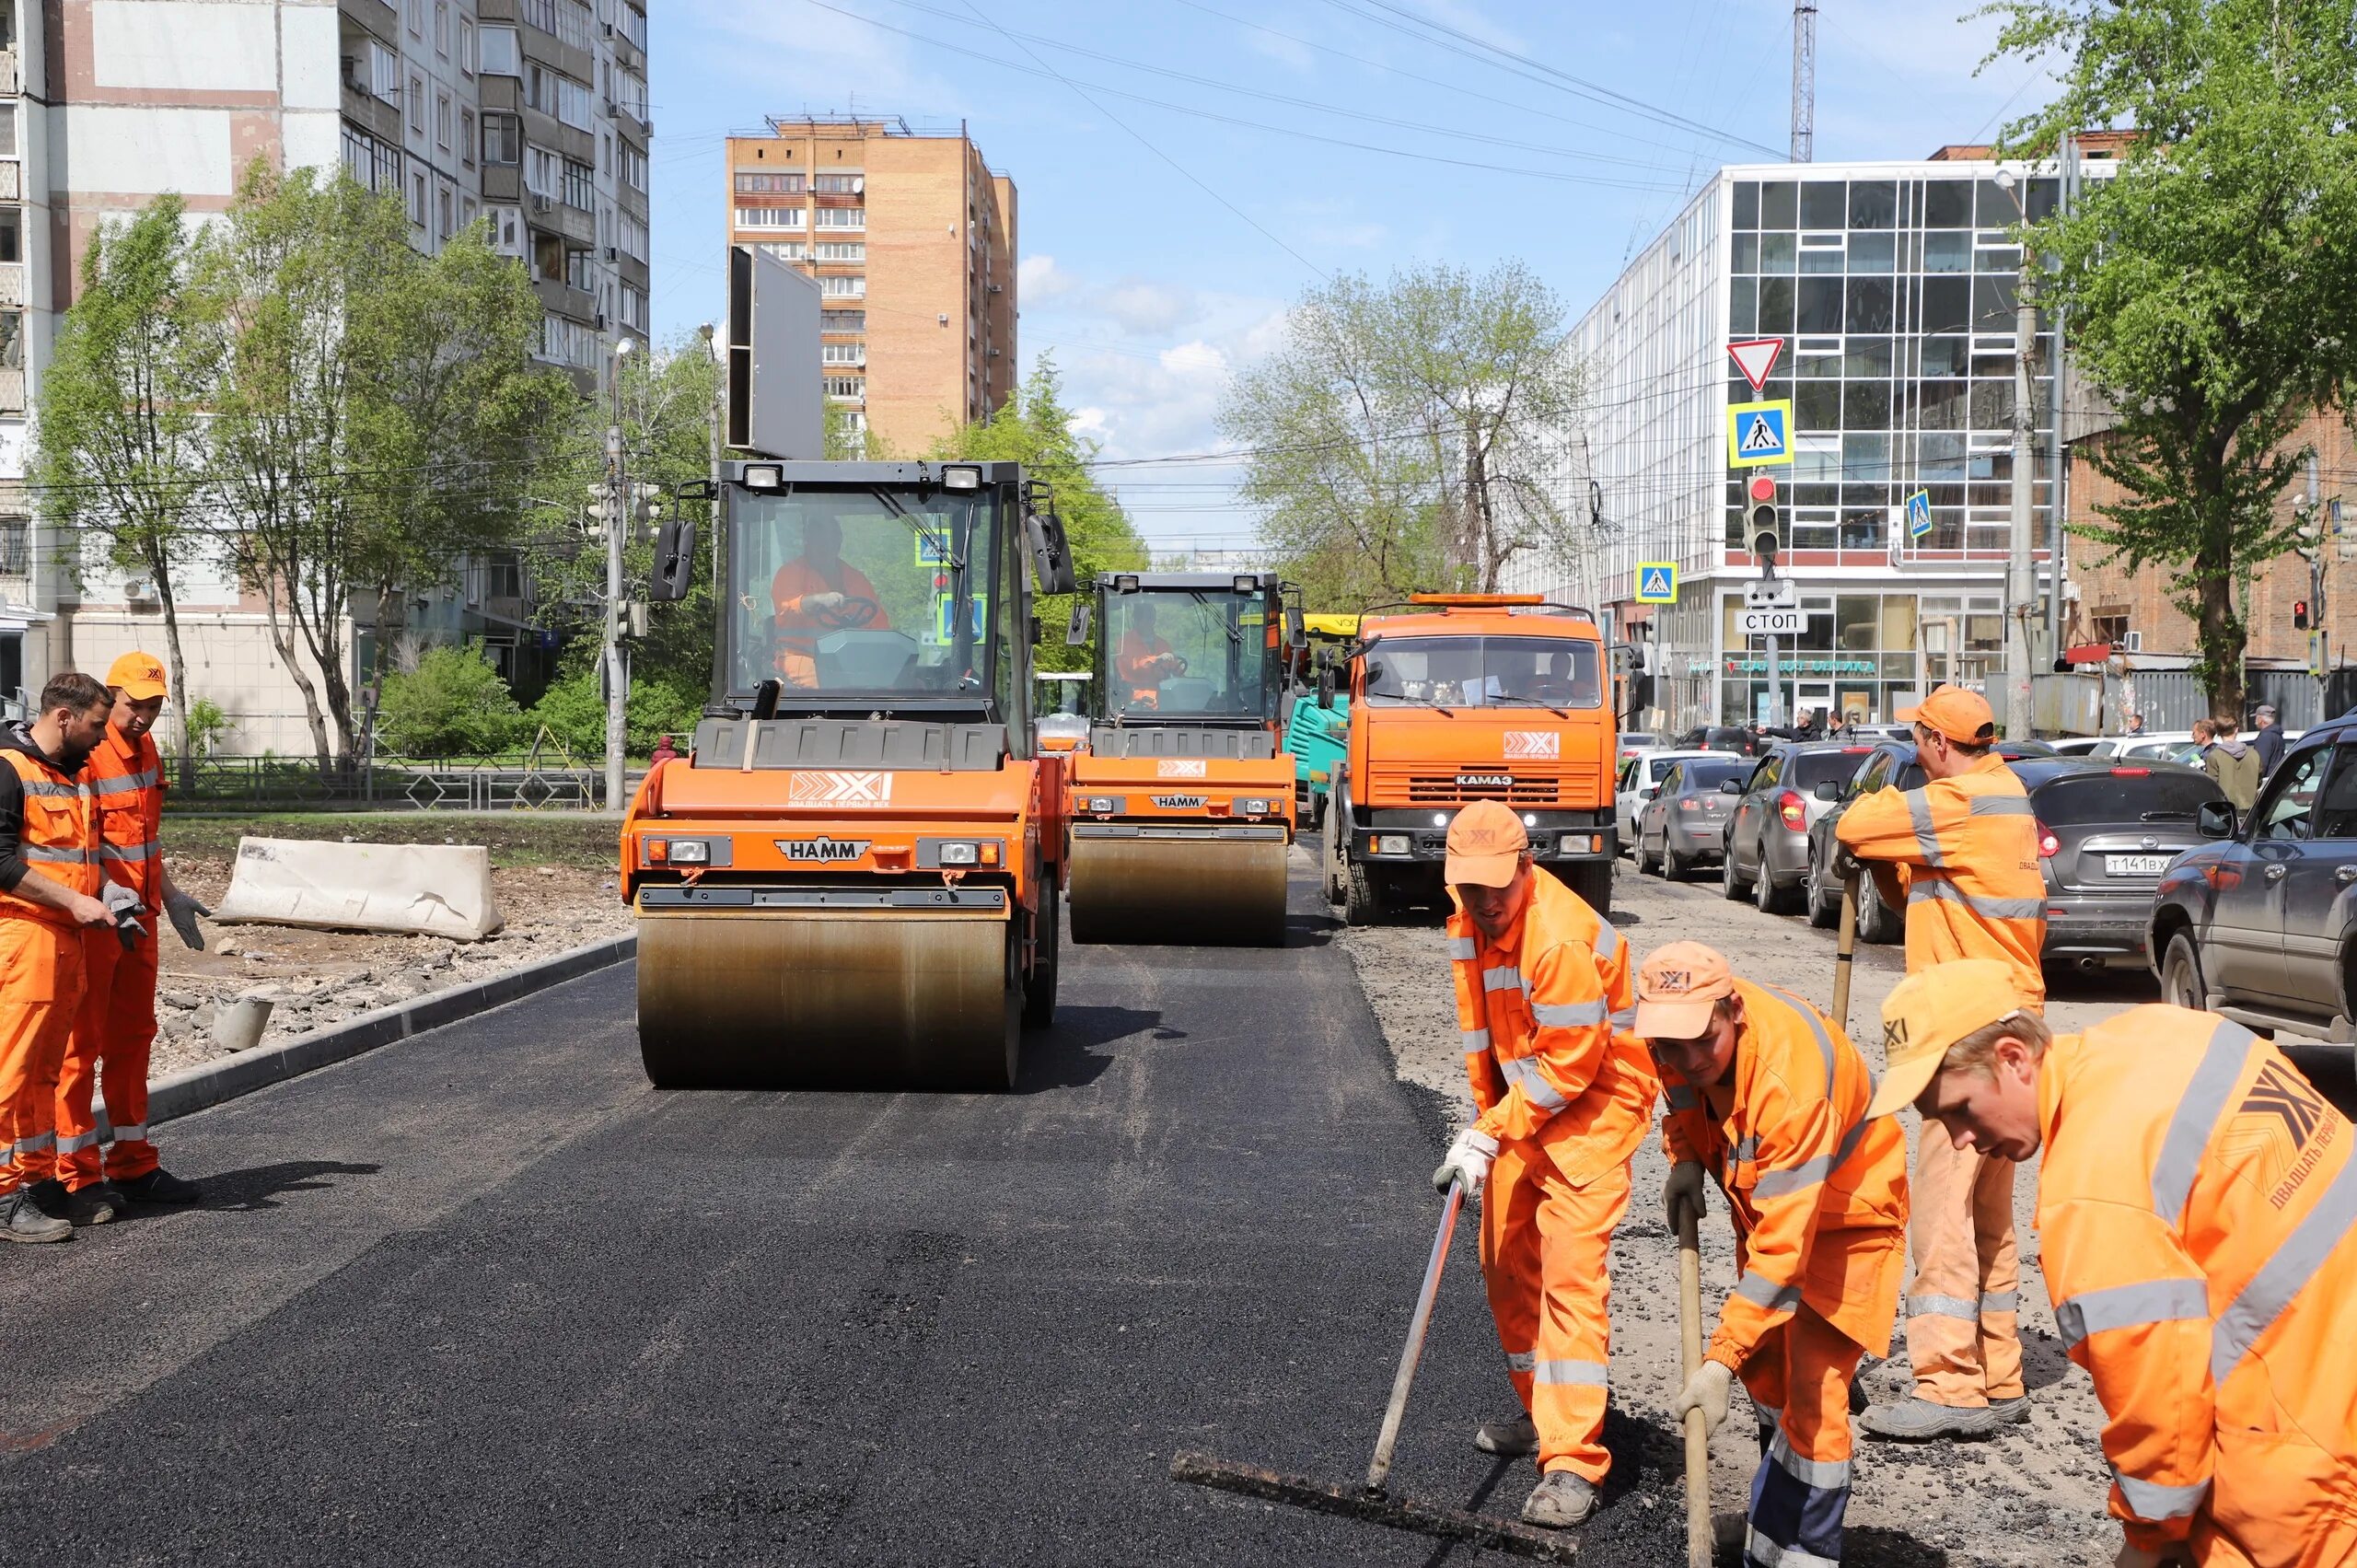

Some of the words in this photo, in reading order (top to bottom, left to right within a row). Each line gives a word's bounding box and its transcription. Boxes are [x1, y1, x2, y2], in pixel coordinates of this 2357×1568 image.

[1746, 614, 1797, 629] СТОП
[1812, 659, 1875, 672] ОПТИКА
[1457, 775, 1513, 785] КАМАЗ
[787, 800, 833, 808] ДВАДЦАТЬ
[1159, 797, 1200, 807] HAMM
[790, 842, 856, 858] HAMM
[2269, 1146, 2324, 1213] ДВАДЦАТЬ
